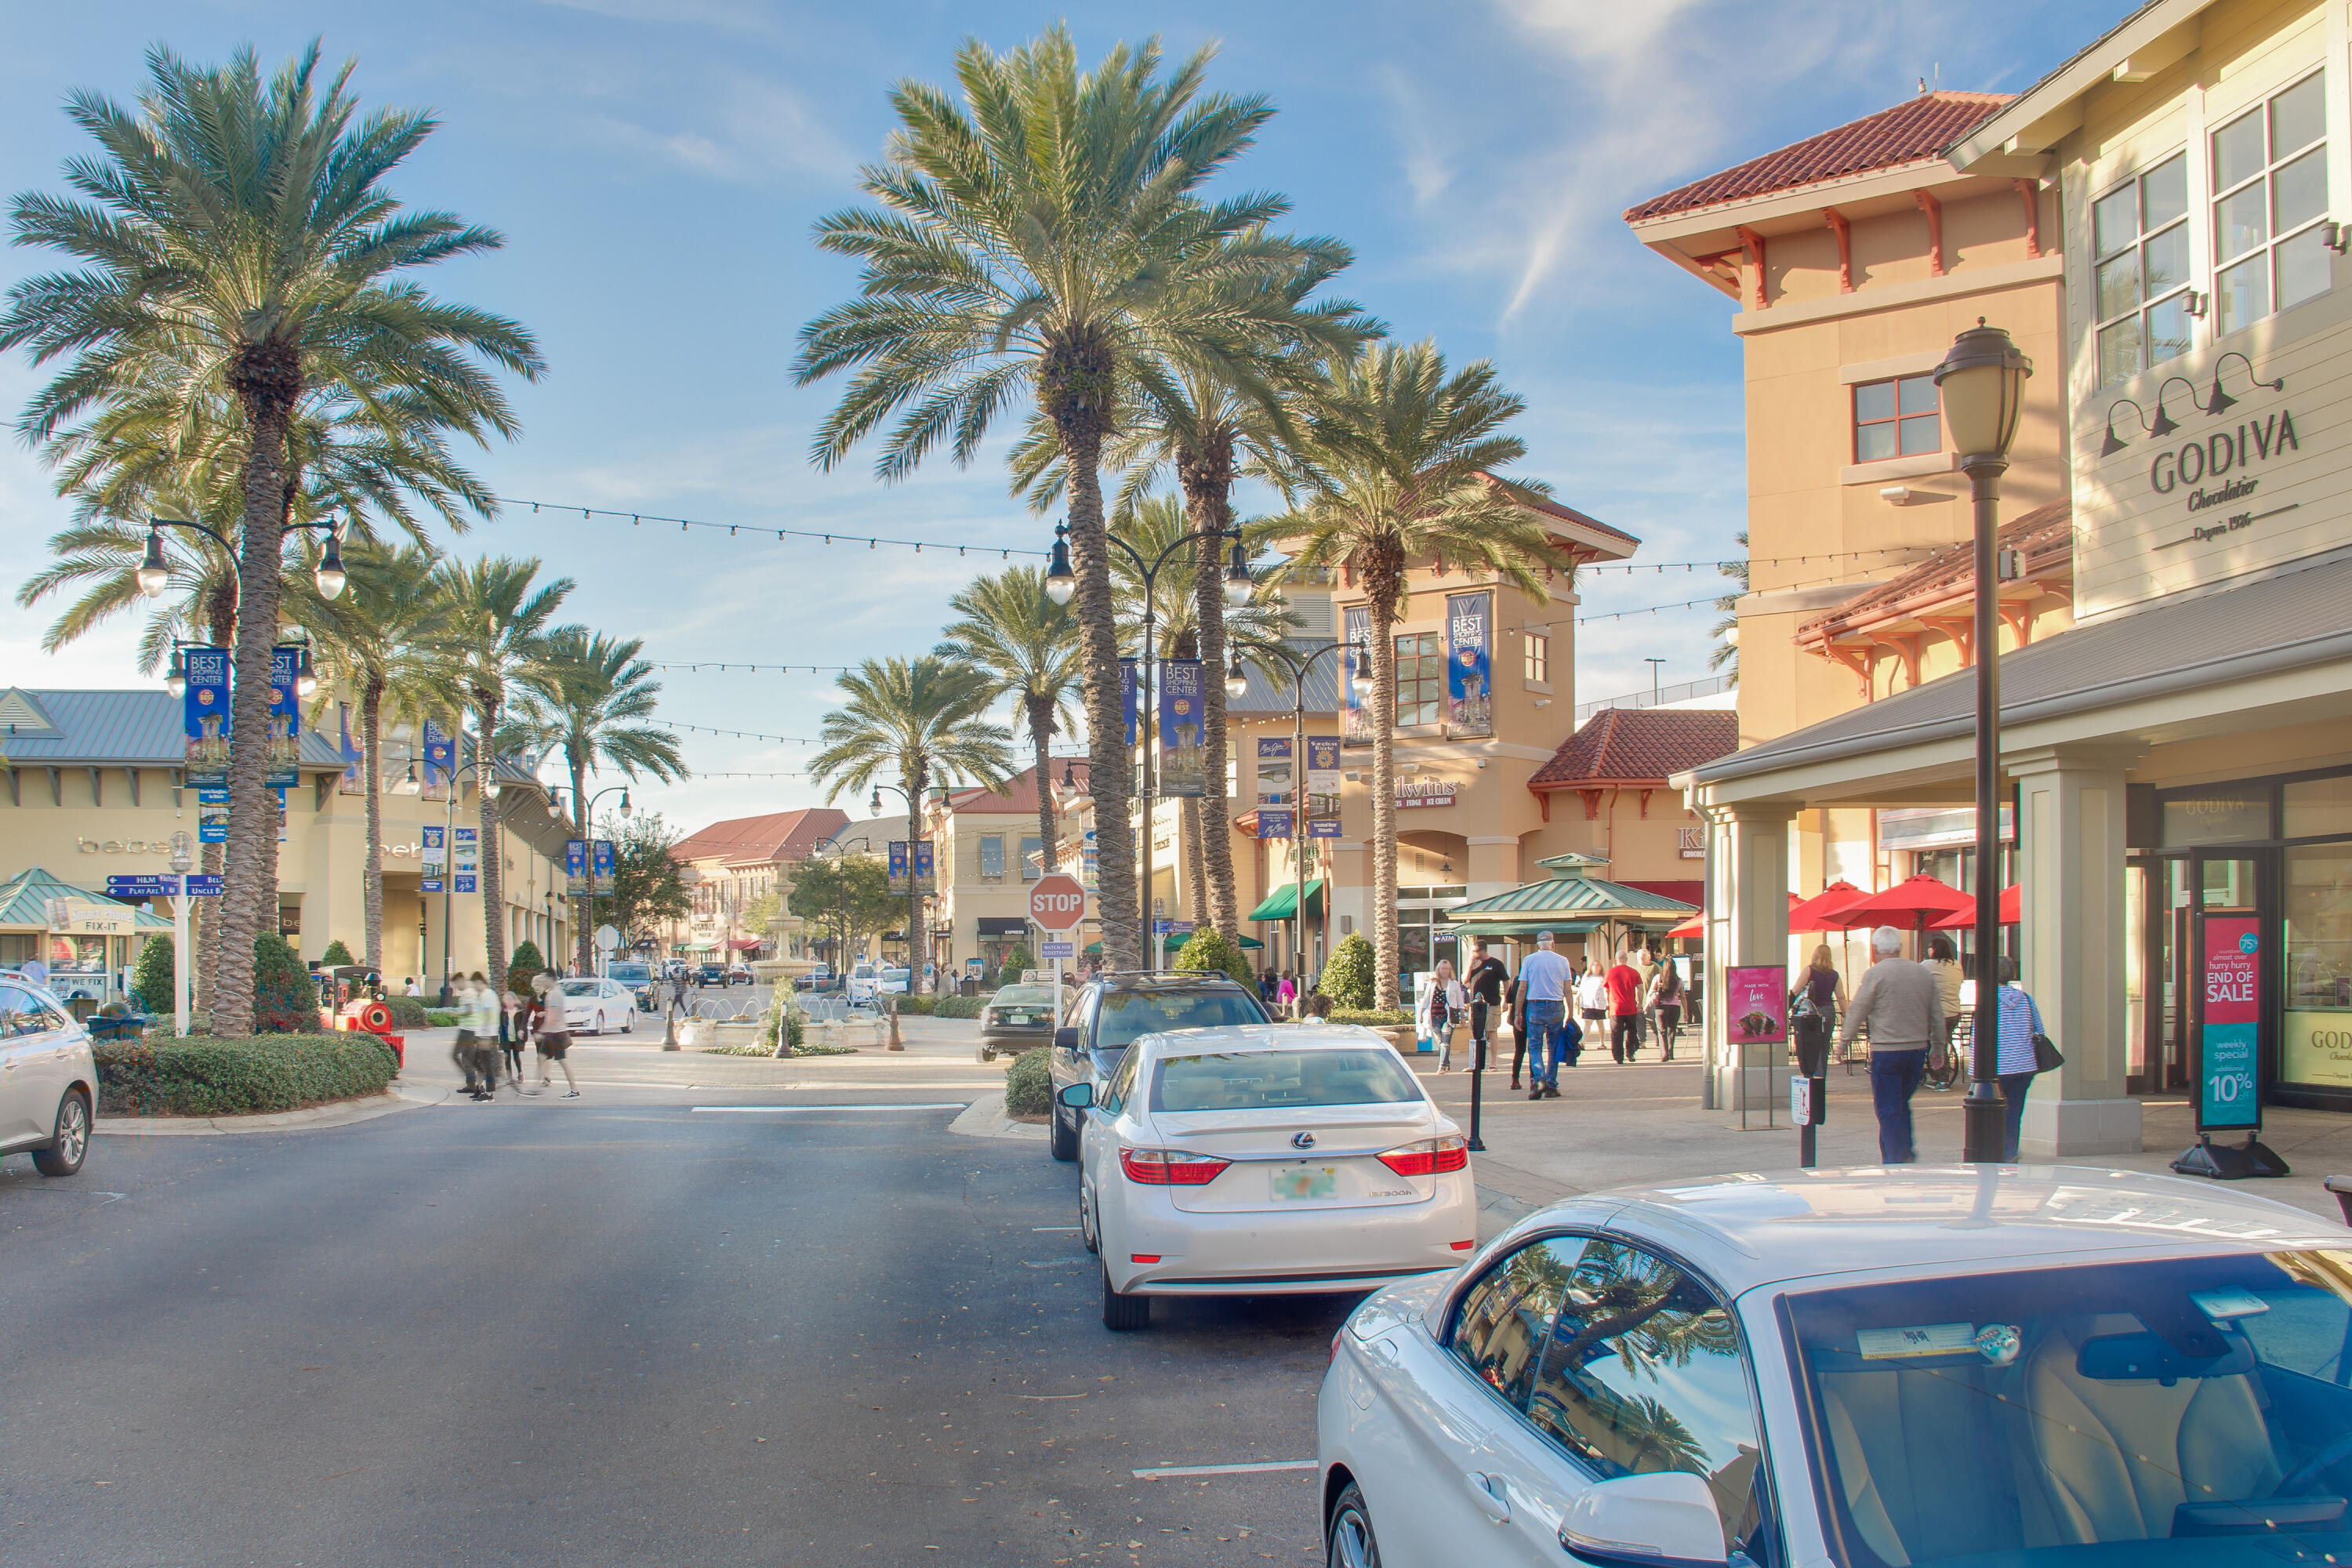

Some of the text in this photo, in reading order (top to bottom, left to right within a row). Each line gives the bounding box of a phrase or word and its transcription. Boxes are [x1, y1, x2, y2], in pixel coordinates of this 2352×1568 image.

[2151, 410, 2298, 494] GODIVA
[2187, 476, 2258, 512] Chocolatier
[2194, 512, 2252, 542] Depuis 1926
[1453, 617, 1483, 633] BEST
[1350, 629, 1372, 644] BES
[1453, 636, 1483, 647] CENTER
[191, 656, 223, 670] BEST
[271, 656, 292, 670] EST
[191, 675, 223, 684] CENTER
[271, 675, 292, 684] NTER
[1166, 667, 1198, 680] BEST
[1166, 686, 1197, 695] CENTER
[1371, 775, 1456, 798] lwins
[2185, 795, 2245, 815] GODIVA
[78, 837, 170, 854] bebe
[1033, 894, 1081, 912] STOP
[71, 908, 132, 923] Smart Phone
[85, 922, 118, 931] FIX-IT
[2209, 960, 2251, 971] hurry hurry
[2207, 971, 2253, 983] END OF
[2207, 983, 2253, 1003] SALE
[2216, 1039, 2247, 1051] weekly
[2311, 1031, 2352, 1049] GOD
[2214, 1047, 2249, 1062] special
[2208, 1073, 2253, 1102] 10%
[2238, 1091, 2250, 1100] off
